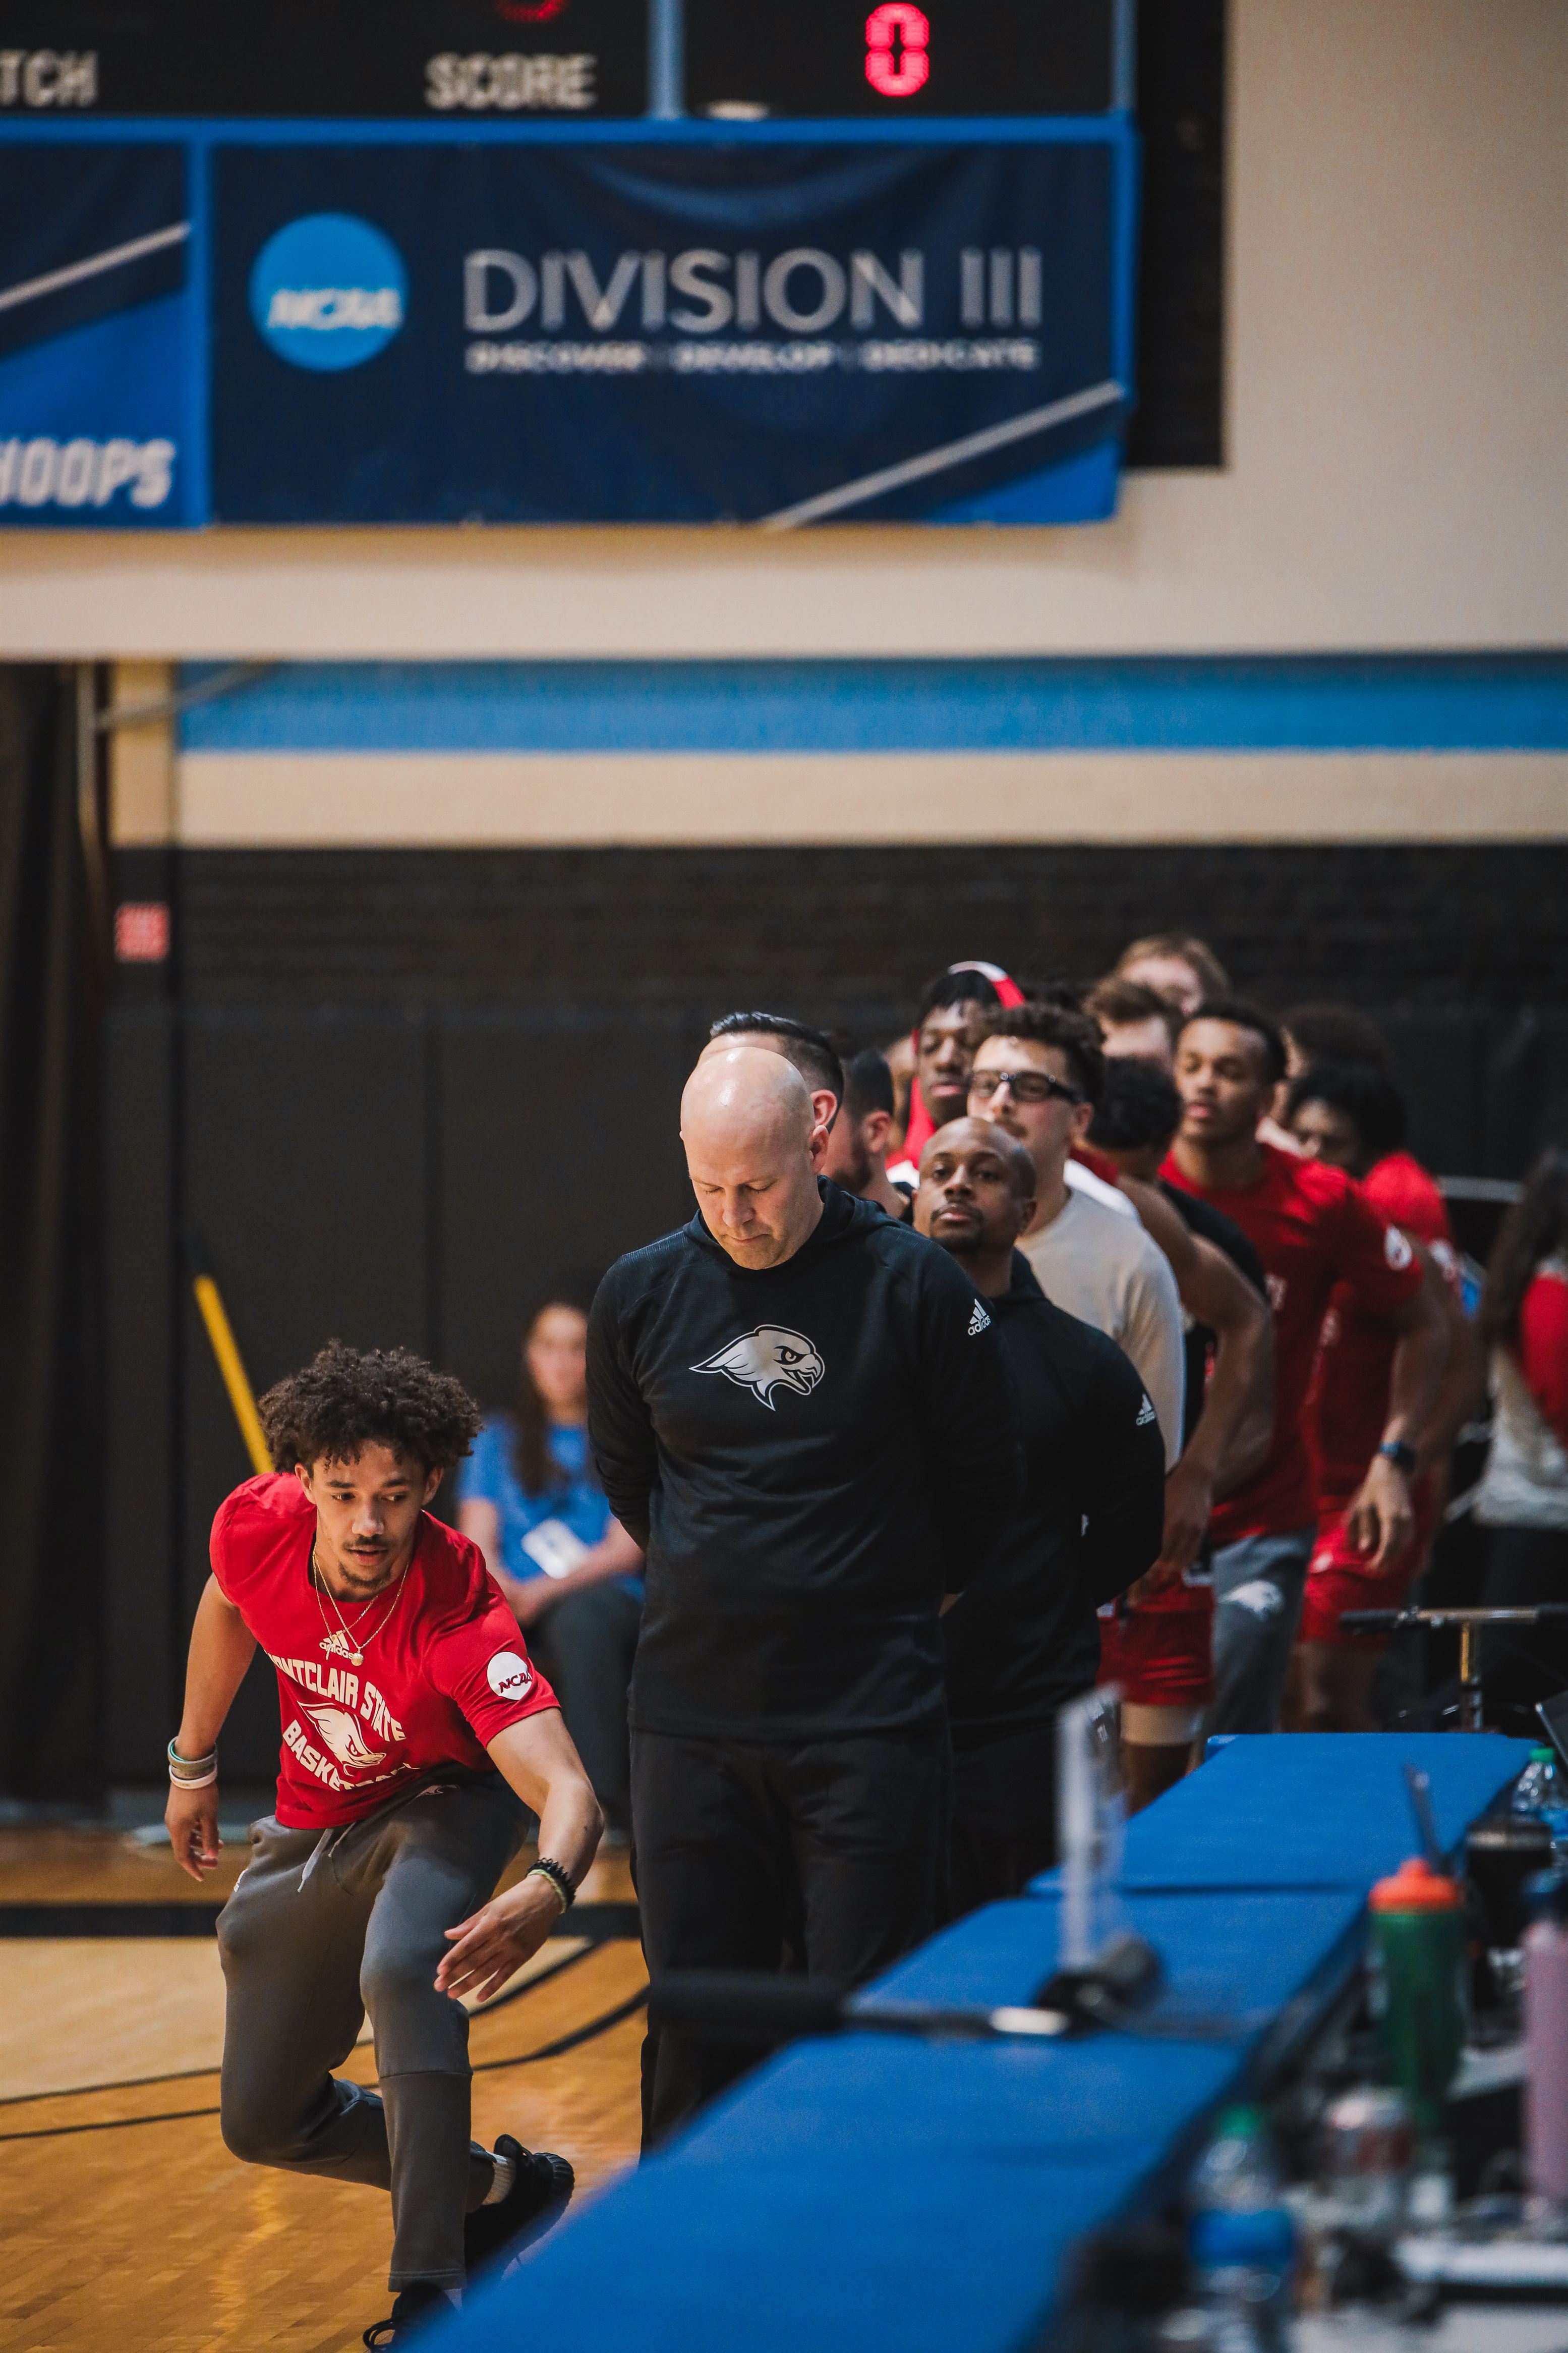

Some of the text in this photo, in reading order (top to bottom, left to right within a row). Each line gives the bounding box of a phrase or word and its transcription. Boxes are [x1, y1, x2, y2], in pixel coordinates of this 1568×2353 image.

[425, 52, 599, 109] SCORE
[265, 287, 403, 330] NCAA
[463, 246, 1042, 332] DIVISION III
[968, 1315, 991, 1336] adidas
[263, 1649, 406, 1742] ONTCLAIR STATE
